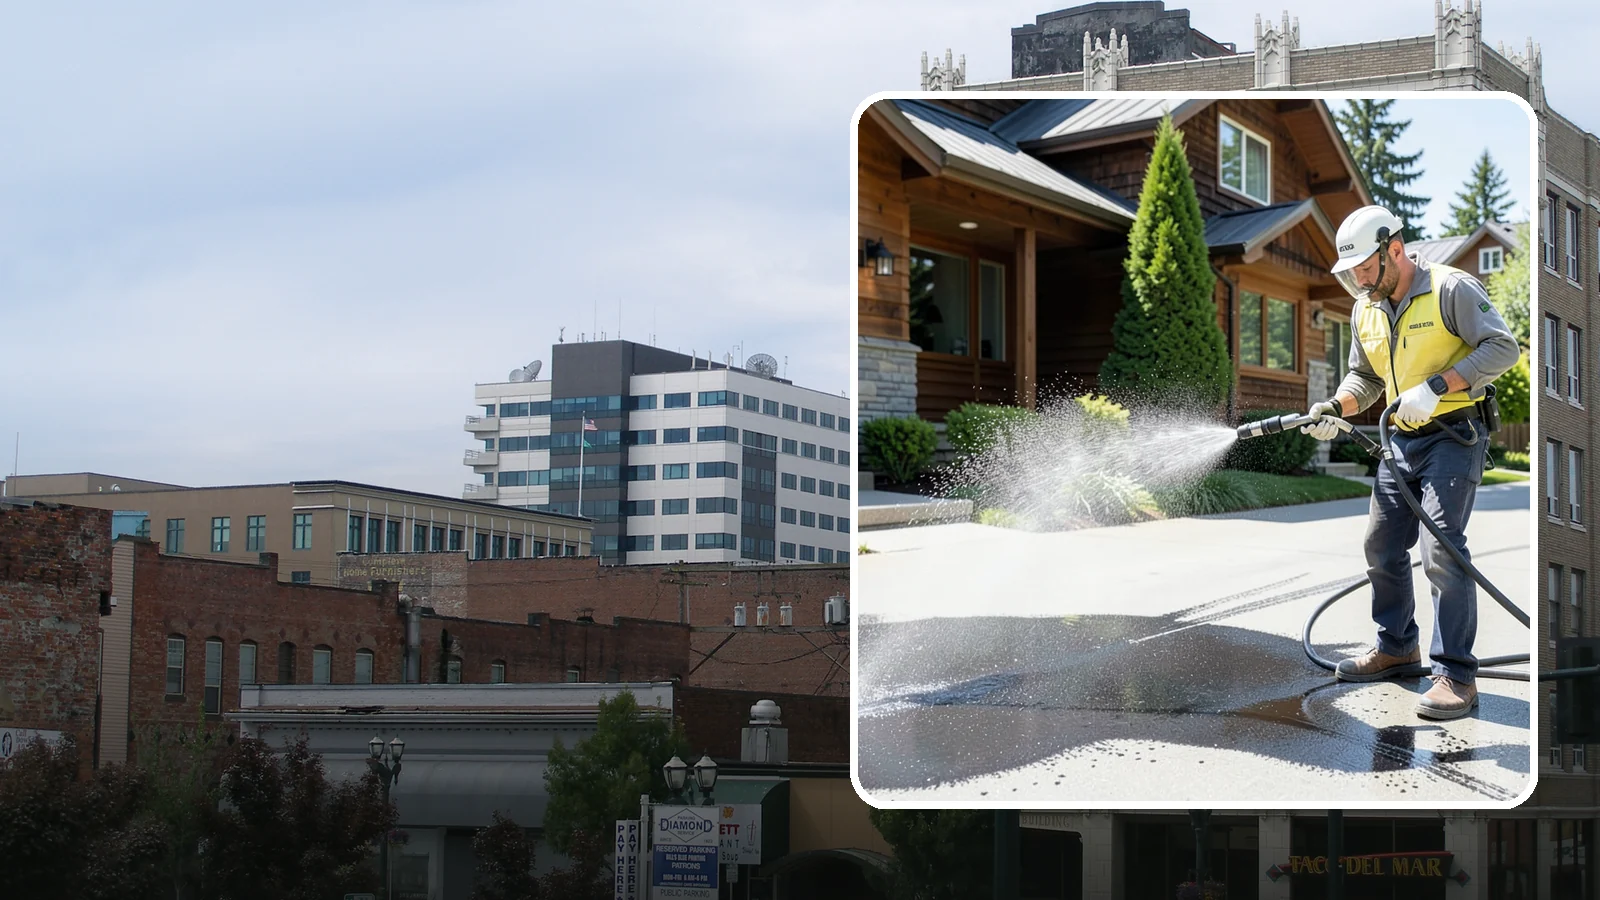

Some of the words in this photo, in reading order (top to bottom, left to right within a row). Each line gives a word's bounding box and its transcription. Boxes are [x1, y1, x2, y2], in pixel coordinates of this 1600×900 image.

[370, 566, 426, 576] Furnishers
[660, 818, 712, 832] DIAMOND
[1021, 815, 1070, 828] BUILDING
[617, 825, 625, 852] PAY
[628, 825, 637, 852] PAY
[616, 856, 625, 893] HERE
[627, 856, 637, 893] HERE
[1346, 856, 1386, 876] DEL
[1392, 856, 1443, 877] MAR
[683, 890, 710, 898] PARKING
